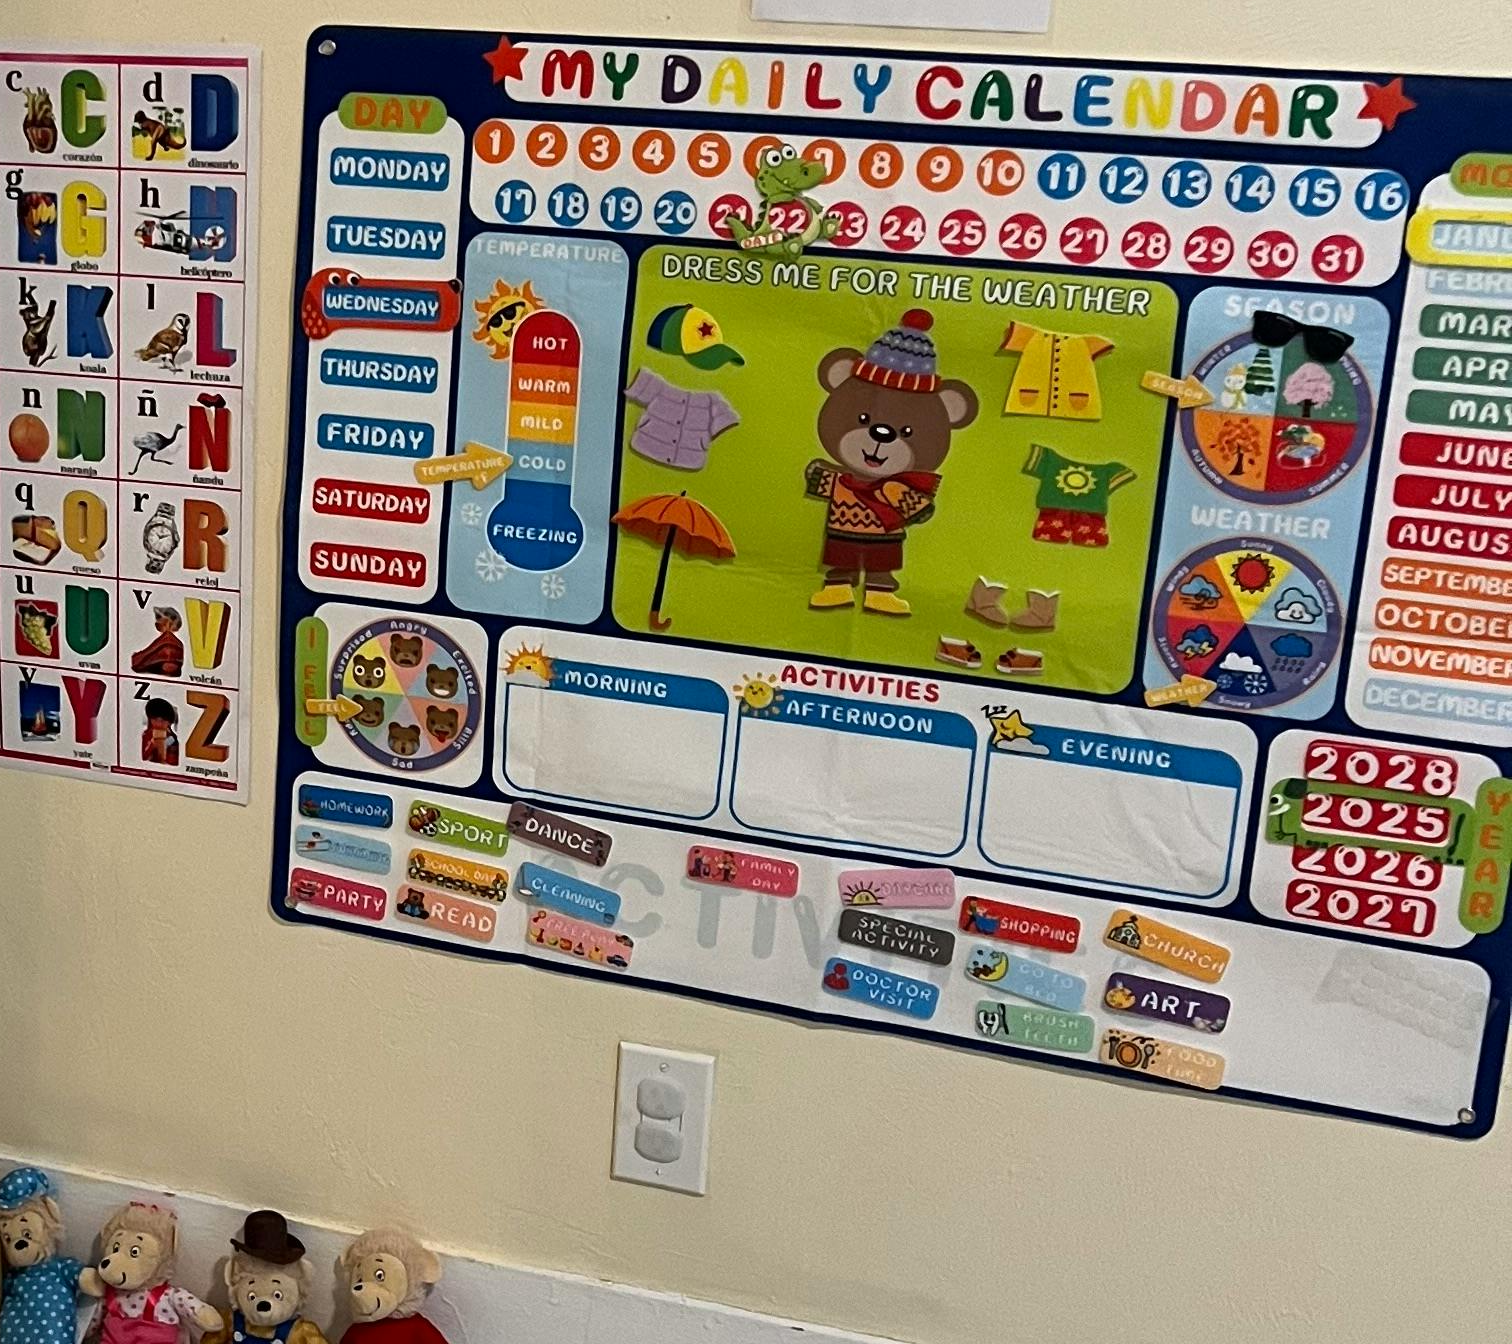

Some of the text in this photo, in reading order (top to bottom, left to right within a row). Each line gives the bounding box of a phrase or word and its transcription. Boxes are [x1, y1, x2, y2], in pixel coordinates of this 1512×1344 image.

[541, 48, 1338, 141] MY DAILY CALENDAR
[143, 72, 239, 151] d D
[354, 96, 432, 130] DAY
[334, 156, 447, 184] MONDAY
[488, 128, 1404, 212] 1 2 3 4 5 11 12 13 14 15 16
[499, 187, 695, 226] 17 18 19 20
[330, 224, 444, 252] TUESDAY
[474, 238, 623, 264] TEMPERATURE
[662, 255, 1150, 317] DRESS ME FOR THE WEATHER
[326, 292, 440, 318] WEDNESDAY
[532, 335, 568, 352] HOT
[190, 370, 230, 382] lechuza
[323, 358, 436, 386] THURSDAY
[518, 376, 571, 395] WARM
[326, 422, 426, 450] FRIDAY
[520, 414, 564, 432] MILD
[518, 454, 567, 472] COLD
[314, 486, 430, 516] SATURDAY
[492, 523, 578, 545] FREEZING
[1190, 505, 1330, 540] WEATHER
[313, 549, 422, 581] SUNDAY
[195, 576, 219, 588] reloj
[390, 621, 428, 635] Angry
[564, 669, 668, 700] MORNING
[780, 664, 940, 703] ACTIVITIES
[786, 698, 933, 736] AFTERNOON
[392, 759, 413, 769] Sad
[1061, 737, 1172, 770] EVENING
[1308, 746, 1453, 796] 2028
[320, 799, 389, 822] HOMEWORK
[1303, 793, 1445, 838] 2025
[438, 818, 509, 850] SPORT
[525, 817, 594, 854] DANCE
[323, 885, 384, 912] PARTY
[531, 877, 606, 914] CLEANING
[1292, 883, 1428, 933] 2027
[430, 903, 492, 933] READ
[1000, 917, 1076, 944] SHOPPING
[1143, 933, 1225, 975] CHURCH
[852, 969, 932, 1001] DOCTOR
[869, 989, 915, 1010] VISIT
[1141, 992, 1201, 1019] ART
